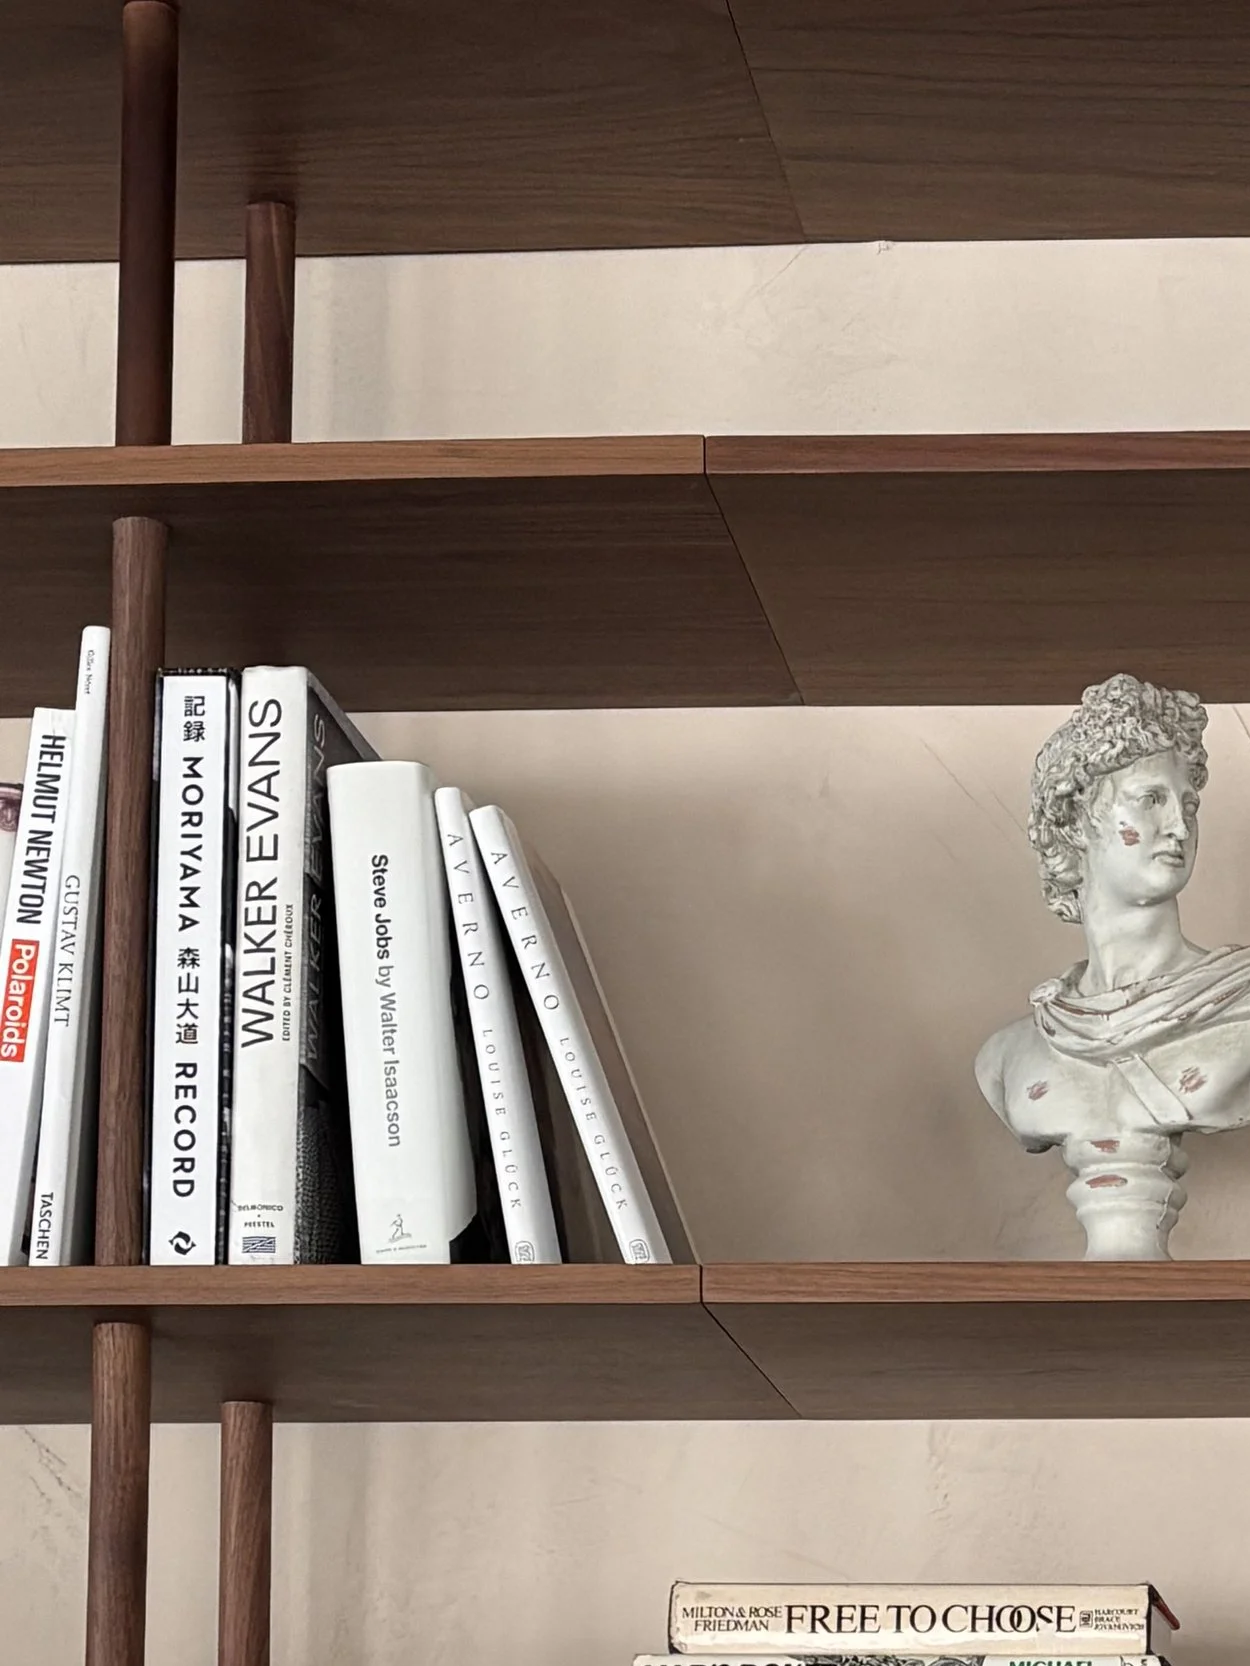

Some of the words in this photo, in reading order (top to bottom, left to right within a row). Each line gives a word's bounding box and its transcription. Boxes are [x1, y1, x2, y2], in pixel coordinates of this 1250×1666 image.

[30, 734, 67, 823] HELMUT
[246, 699, 283, 863] EVANS
[16, 829, 54, 925] NEWTON
[178, 757, 205, 932] MORIYAMA
[371, 854, 389, 909] Steve
[60, 875, 80, 955] GUSTAV
[375, 913, 393, 960] Jobs
[0, 943, 36, 1058] Polaroids
[54, 962, 74, 1027] KLIMT
[175, 947, 201, 1045] 森山大道
[241, 876, 278, 1048] WALKER
[376, 965, 395, 989] by
[282, 1008, 291, 1042] EDITED
[284, 997, 292, 1009] BY
[380, 992, 397, 1055] Walter
[447, 833, 490, 1000] AVERNO
[482, 1029, 507, 1116] LOUISE
[500, 1131, 522, 1209] GLÜCK
[491, 851, 560, 1011] AVERNO
[560, 1037, 598, 1121] LOUISE
[594, 1134, 629, 1210] GLÜCK
[172, 1063, 198, 1198] RECORD
[384, 1059, 402, 1147] Isaacson
[36, 1192, 54, 1259] TASCHEN
[682, 1606, 735, 1618] MILTON
[749, 1606, 783, 1618] ROSE
[694, 1619, 769, 1632] FRIEDMAN
[785, 1604, 882, 1634] FREE
[886, 1604, 937, 1633] TO
[942, 1604, 1077, 1634] CHOOSE
